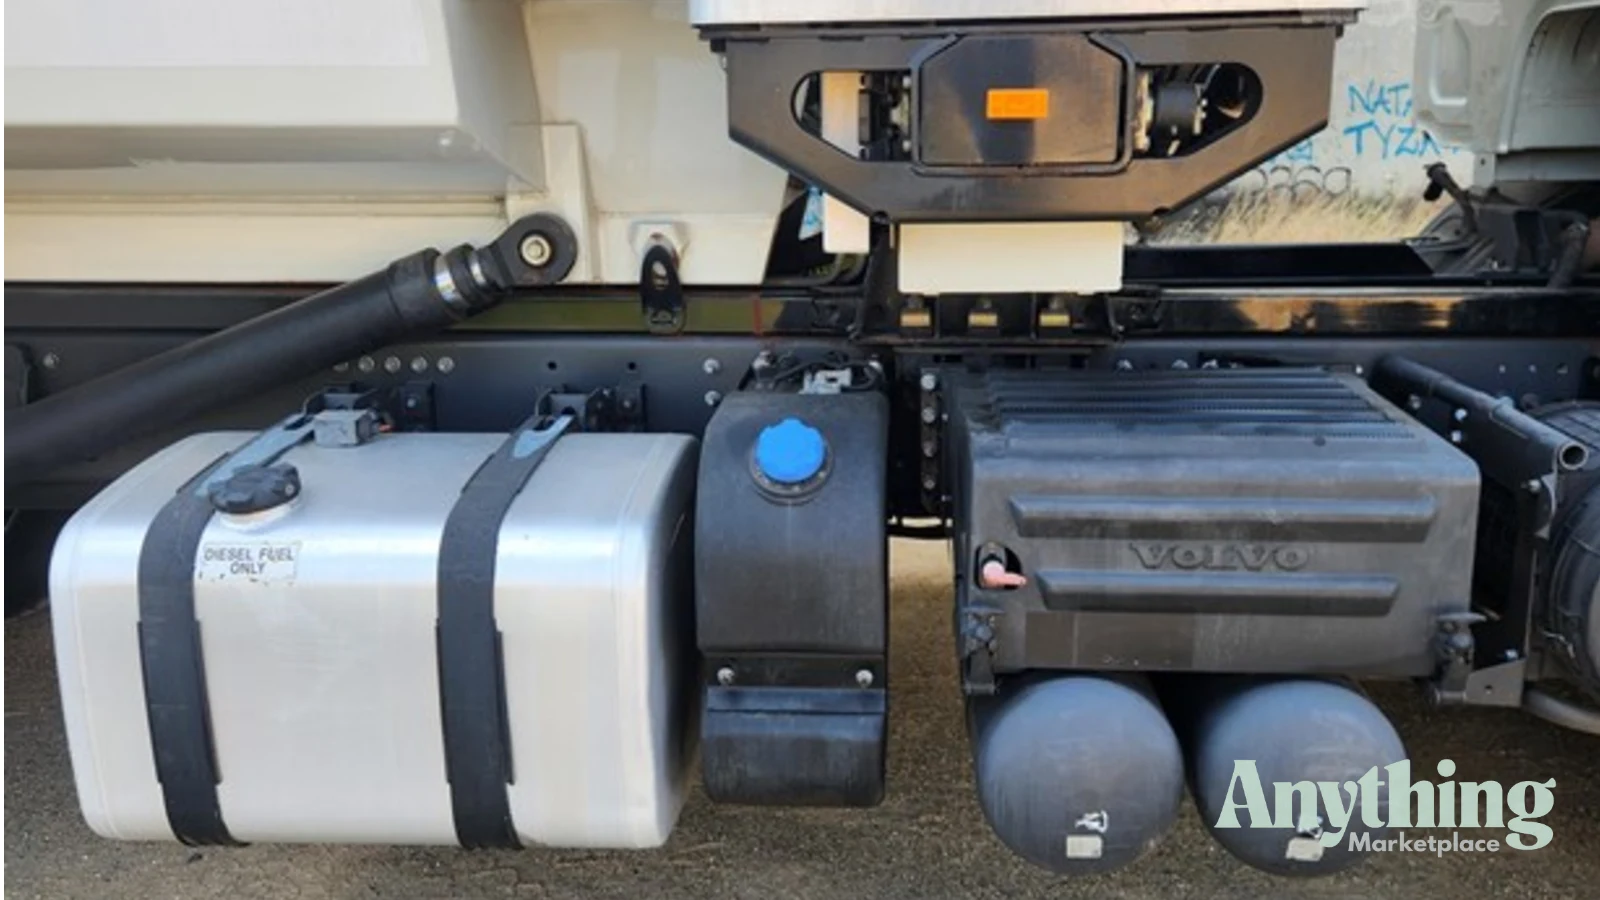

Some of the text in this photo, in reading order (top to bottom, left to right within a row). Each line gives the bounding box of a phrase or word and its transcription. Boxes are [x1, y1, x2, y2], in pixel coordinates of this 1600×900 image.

[204, 547, 294, 561] DIESEL FUEL
[1129, 542, 1310, 571] VOLVO
[230, 561, 266, 574] ONLY
